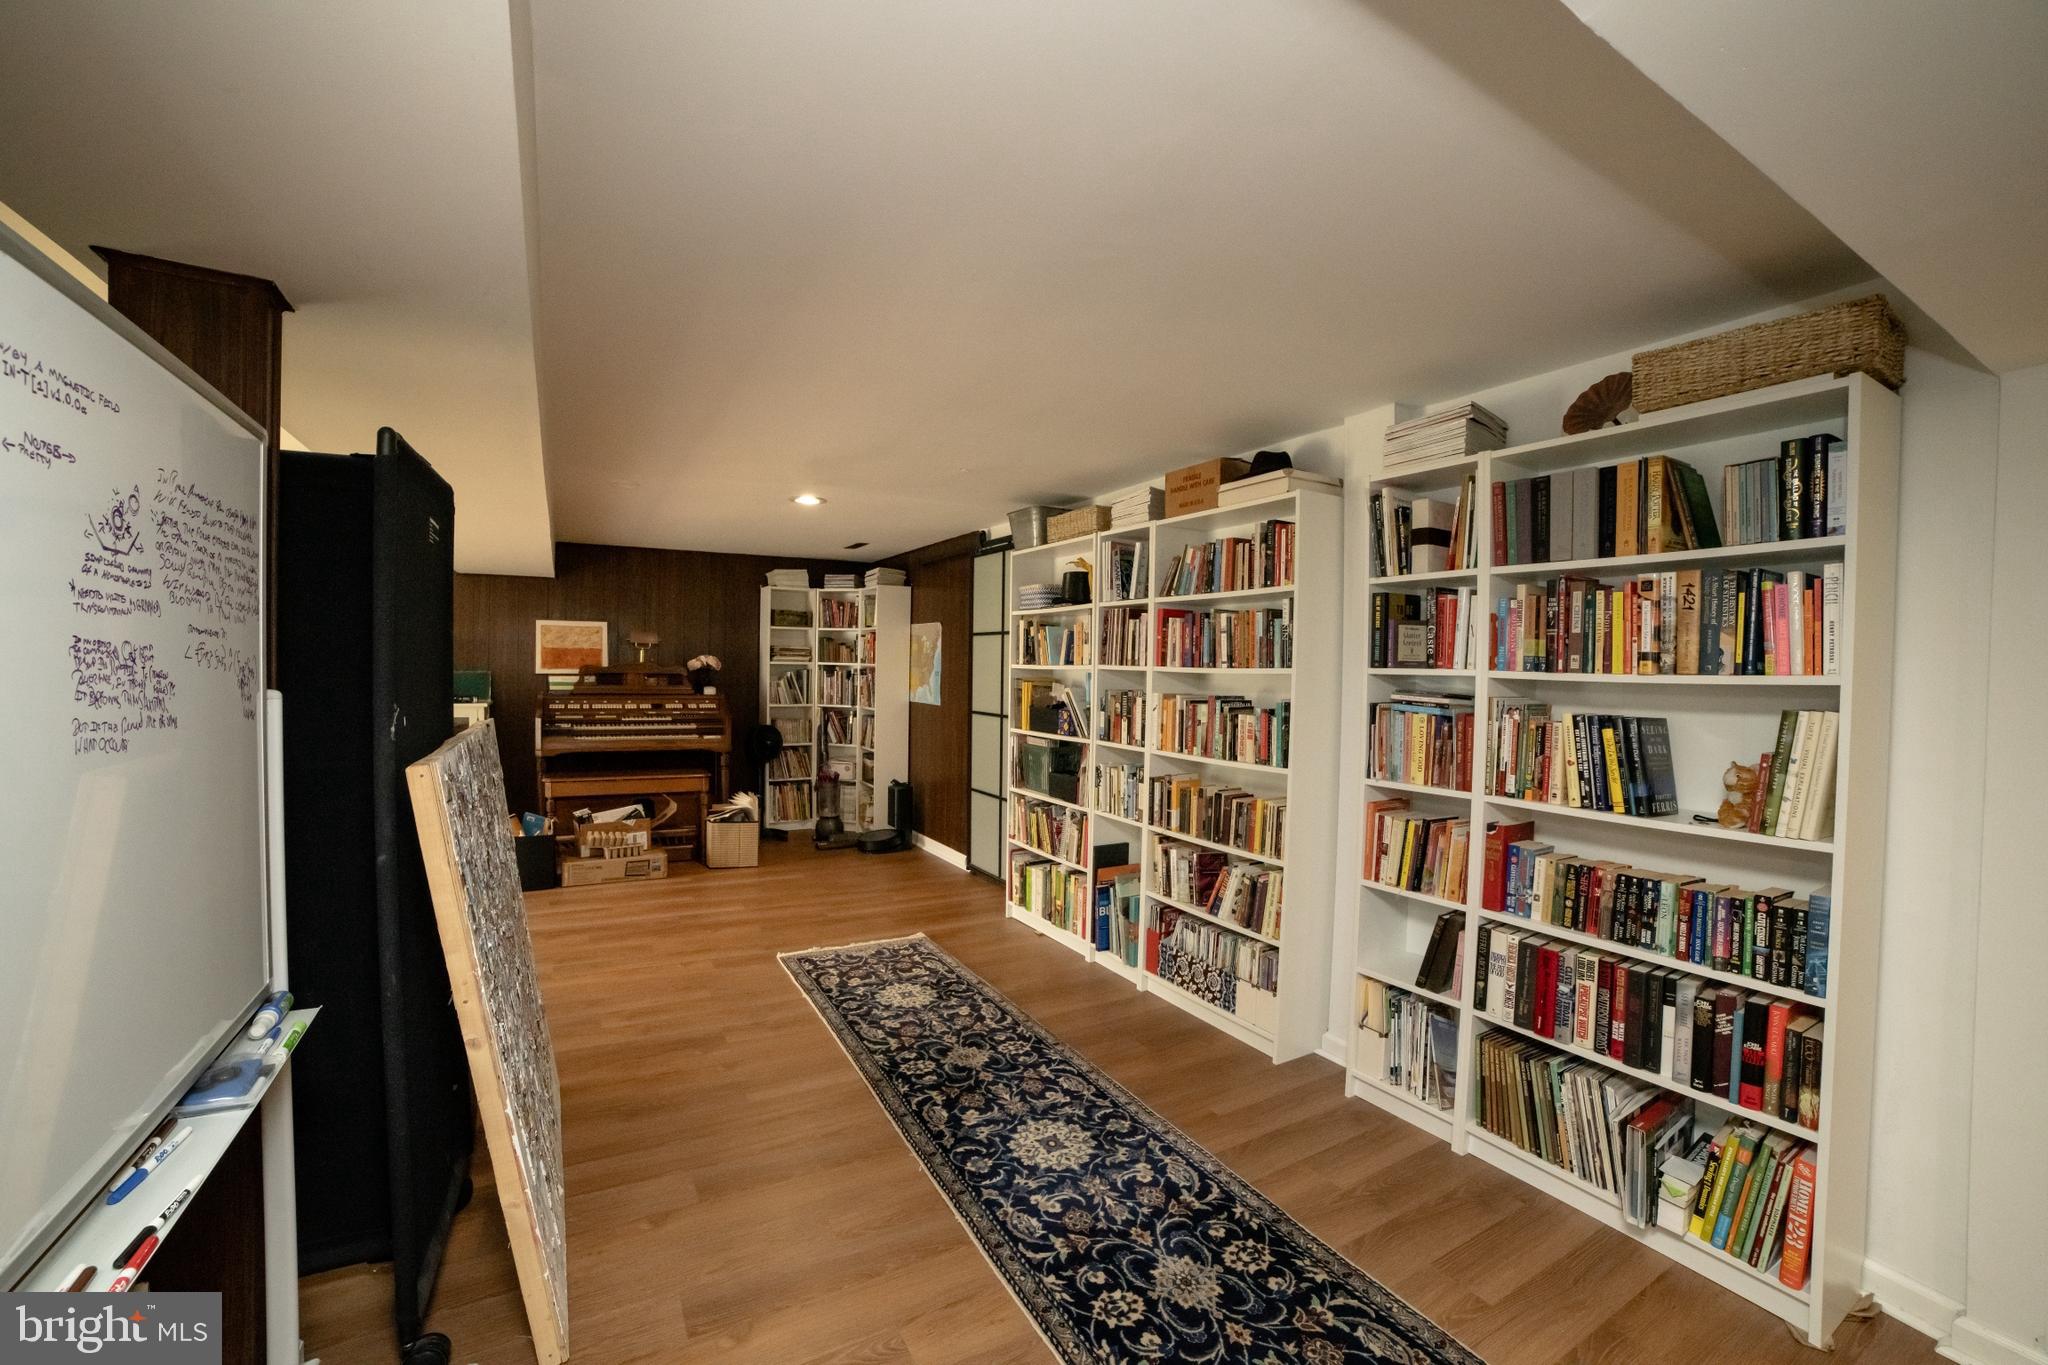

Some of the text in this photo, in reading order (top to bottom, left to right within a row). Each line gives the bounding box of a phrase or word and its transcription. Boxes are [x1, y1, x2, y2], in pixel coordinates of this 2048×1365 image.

[1651, 471, 1661, 520] HARRY POTTER
[1682, 583, 1696, 611] 1421
[1728, 581, 1737, 626] THE HISTORY
[1824, 576, 1839, 606] PENCIL
[1721, 590, 1730, 627] STATISTICS
[1426, 625, 1437, 655] Caste
[1416, 726, 1425, 773] LOVING GOD
[1647, 743, 1668, 754] DARK
[1791, 722, 1816, 819] TUFTE VISUAL EXPLANATIONS
[1652, 800, 1678, 813] FERRIS
[1480, 930, 1488, 955] JEFFREY
[1756, 912, 1766, 948] CLIVE CUSSLER
[1556, 955, 1566, 984] CUSSLER
[1564, 966, 1573, 986] CLIVE
[1576, 957, 1587, 981] LUDLUM
[1585, 959, 1596, 982] ROBERT
[1771, 961, 1779, 984] GRISHAM
[1790, 965, 1799, 987] GRISHAM
[1797, 970, 1805, 984] JOHN
[1562, 1001, 1571, 1028] TROJAN
[1576, 985, 1591, 1040] APOCALYPSE WATCH
[1596, 991, 1610, 1025] PATTERSON
[1697, 1160, 1718, 1211] Sewing Dummies
[1796, 1179, 1812, 1217] HOME
